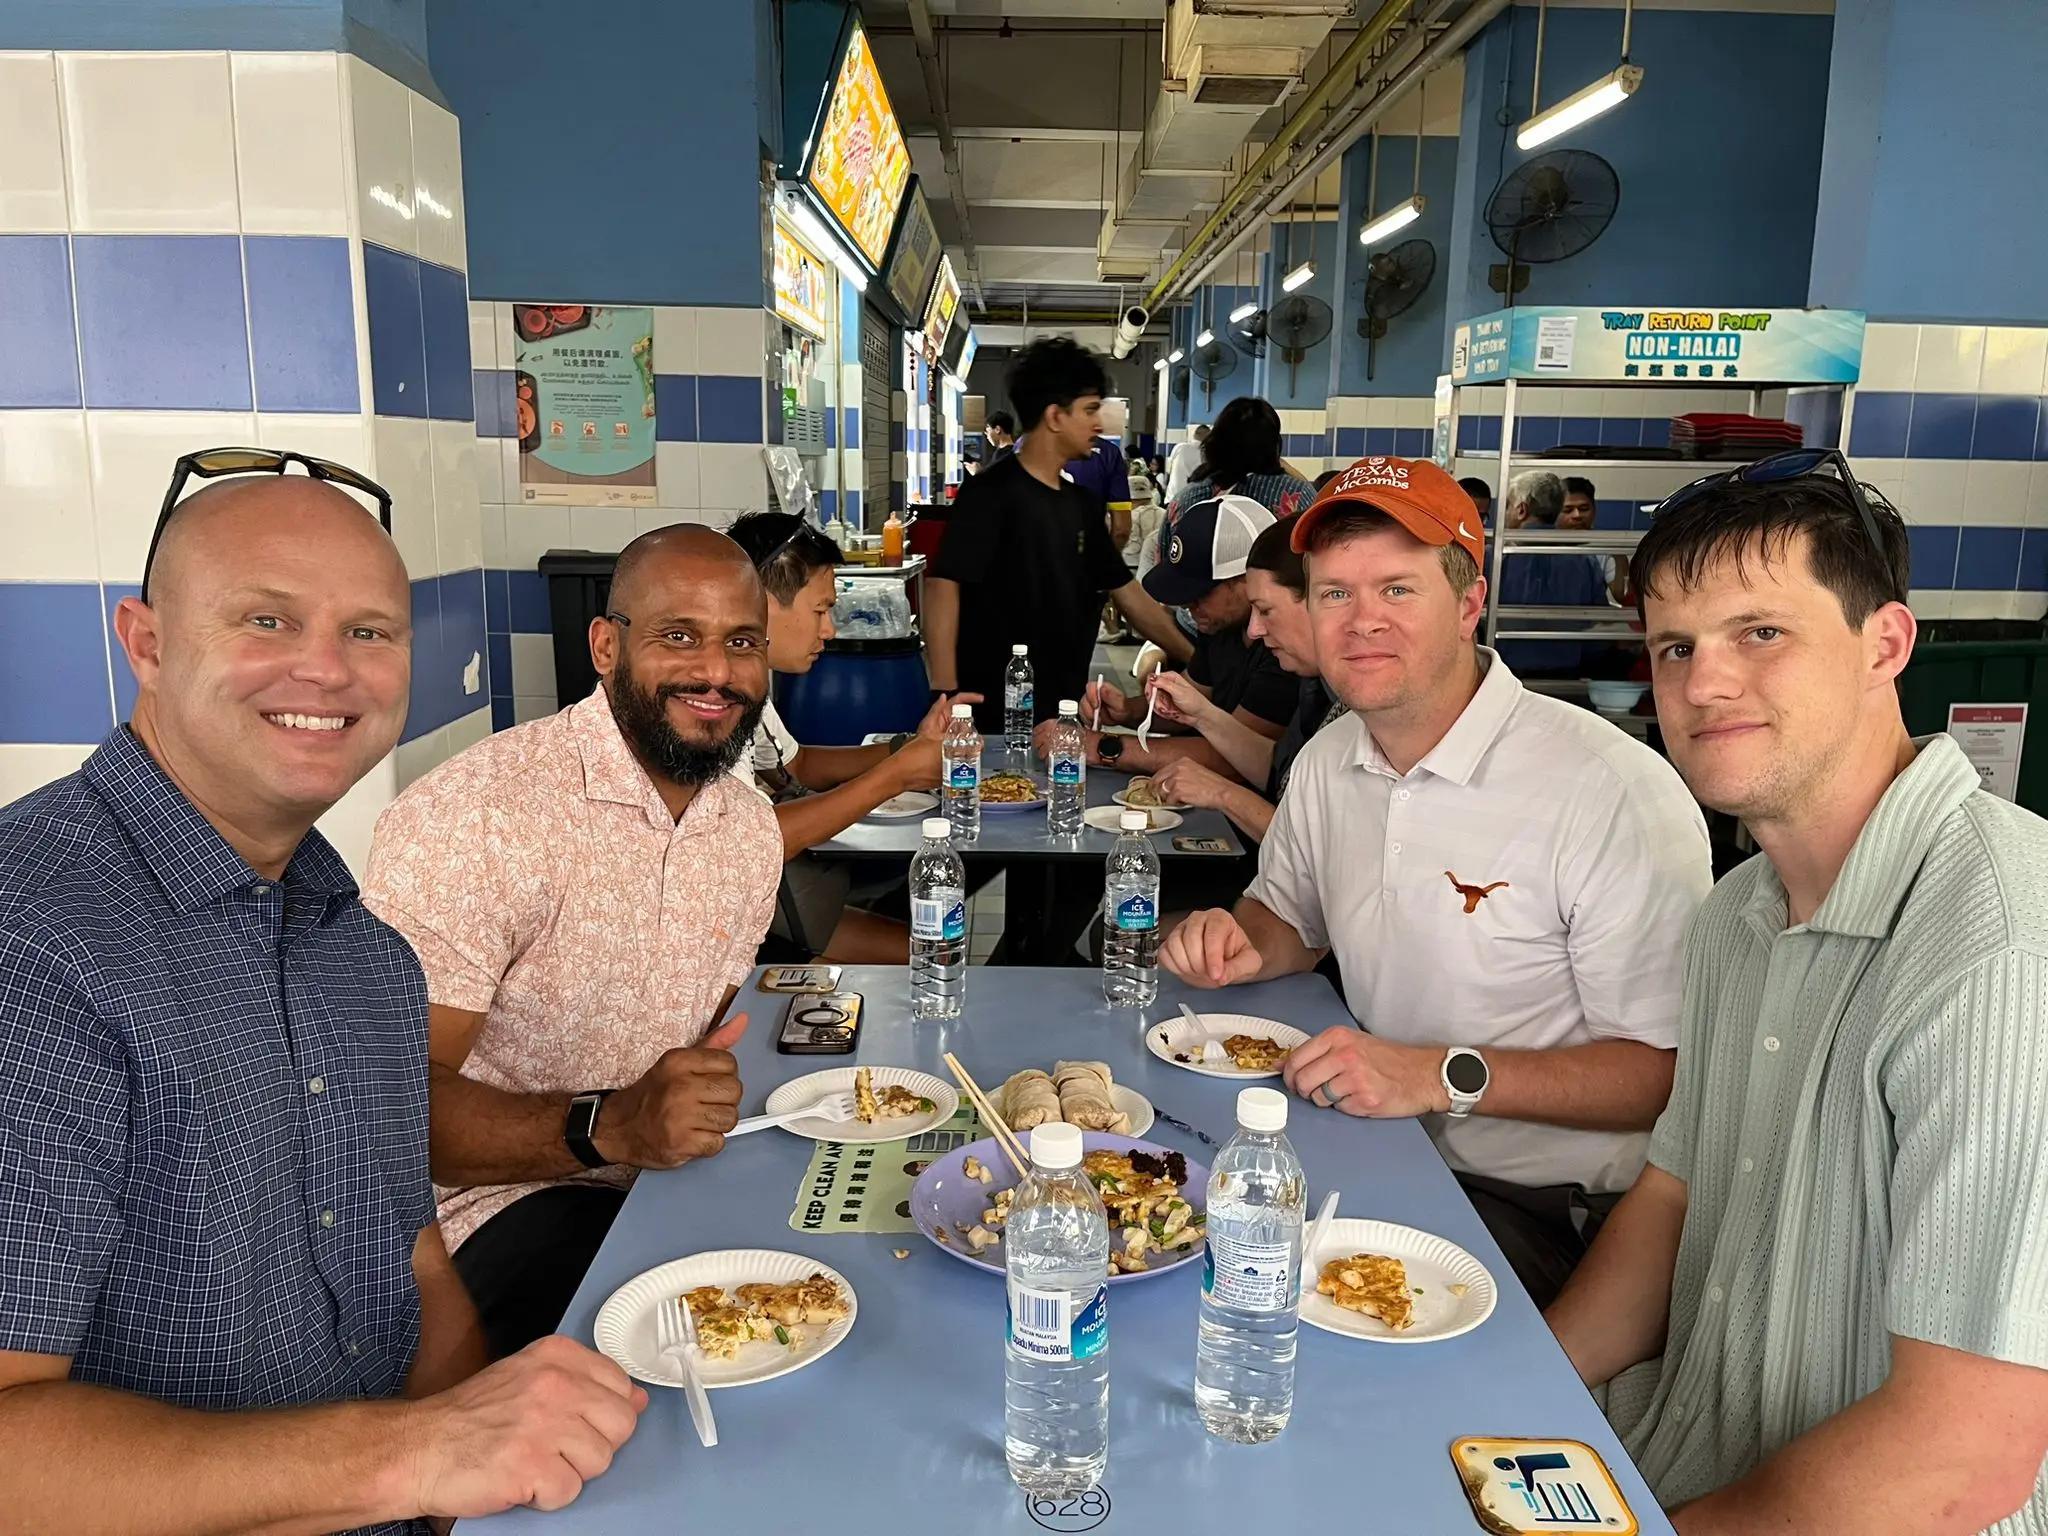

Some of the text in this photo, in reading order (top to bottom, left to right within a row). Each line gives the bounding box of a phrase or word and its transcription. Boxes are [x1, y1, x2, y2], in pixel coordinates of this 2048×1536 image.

[1601, 312, 1772, 331] TRAY RETURN POINT
[1628, 335, 1738, 357] NON-HALAL
[1341, 464, 1409, 482] TEXAS
[1333, 475, 1410, 495] McCombs
[812, 1161, 839, 1198] CLEAN
[802, 1200, 827, 1229] KEEP
[1050, 1344, 1070, 1355] 500ml
[1032, 1490, 1105, 1516] 628
